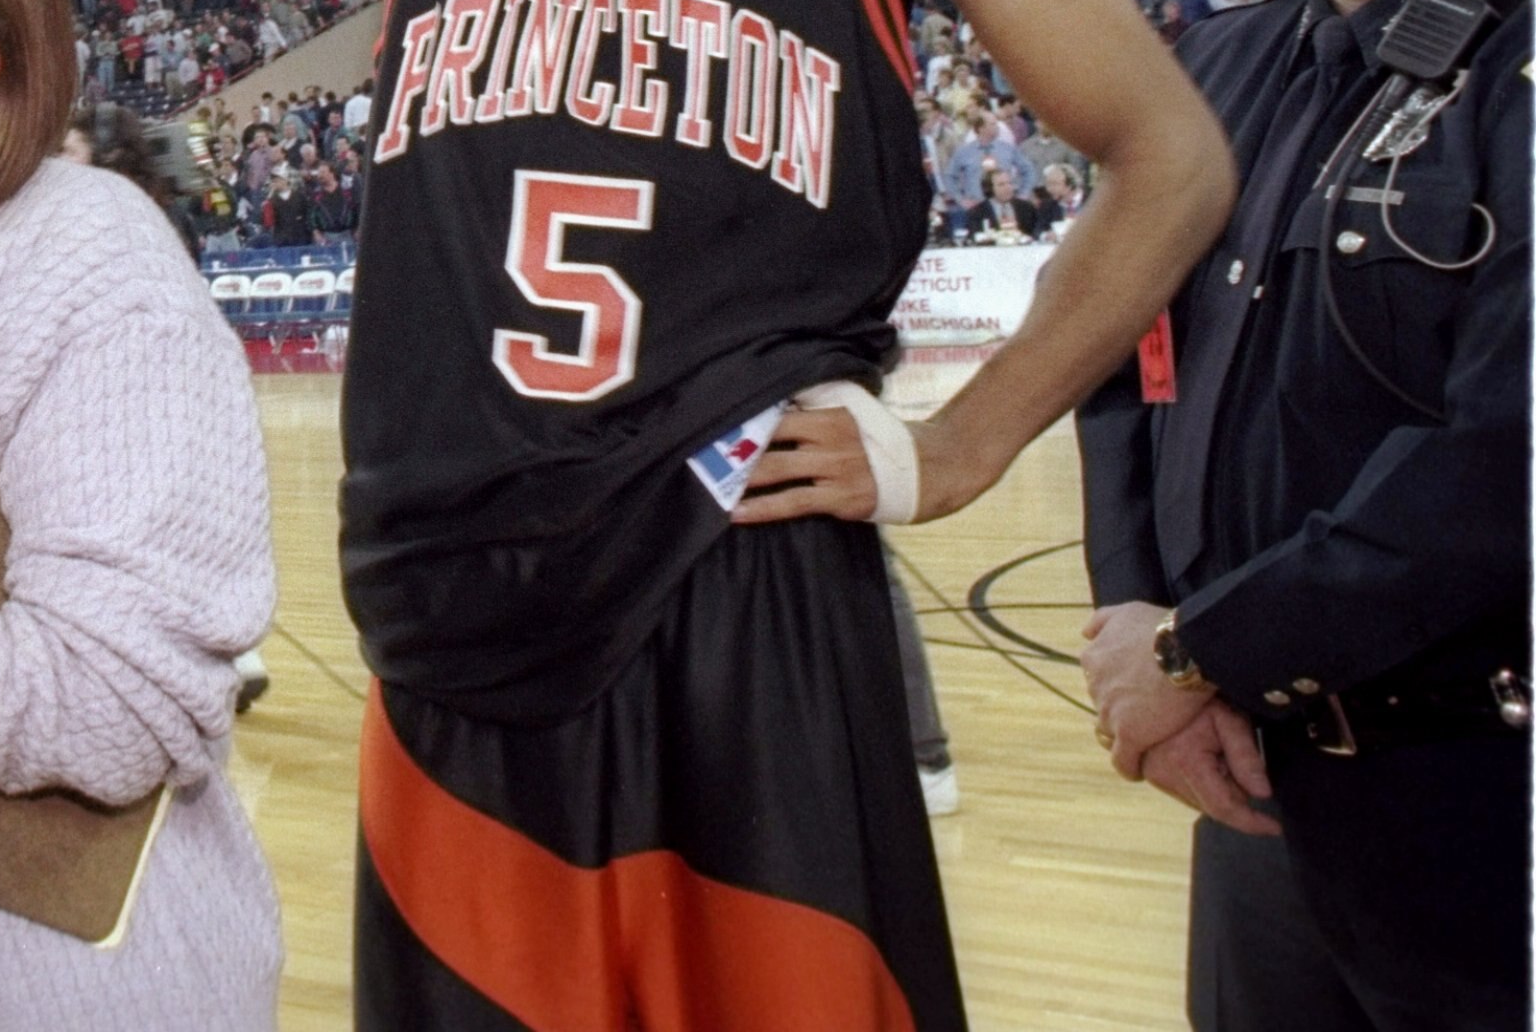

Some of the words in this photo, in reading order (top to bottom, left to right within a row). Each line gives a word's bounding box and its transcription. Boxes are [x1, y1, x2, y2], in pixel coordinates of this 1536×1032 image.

[915, 258, 945, 272] ATE
[492, 169, 655, 402] 5
[906, 276, 973, 292] CTICUT
[896, 298, 930, 313] UKE
[909, 316, 1001, 330] MICHIGAN
